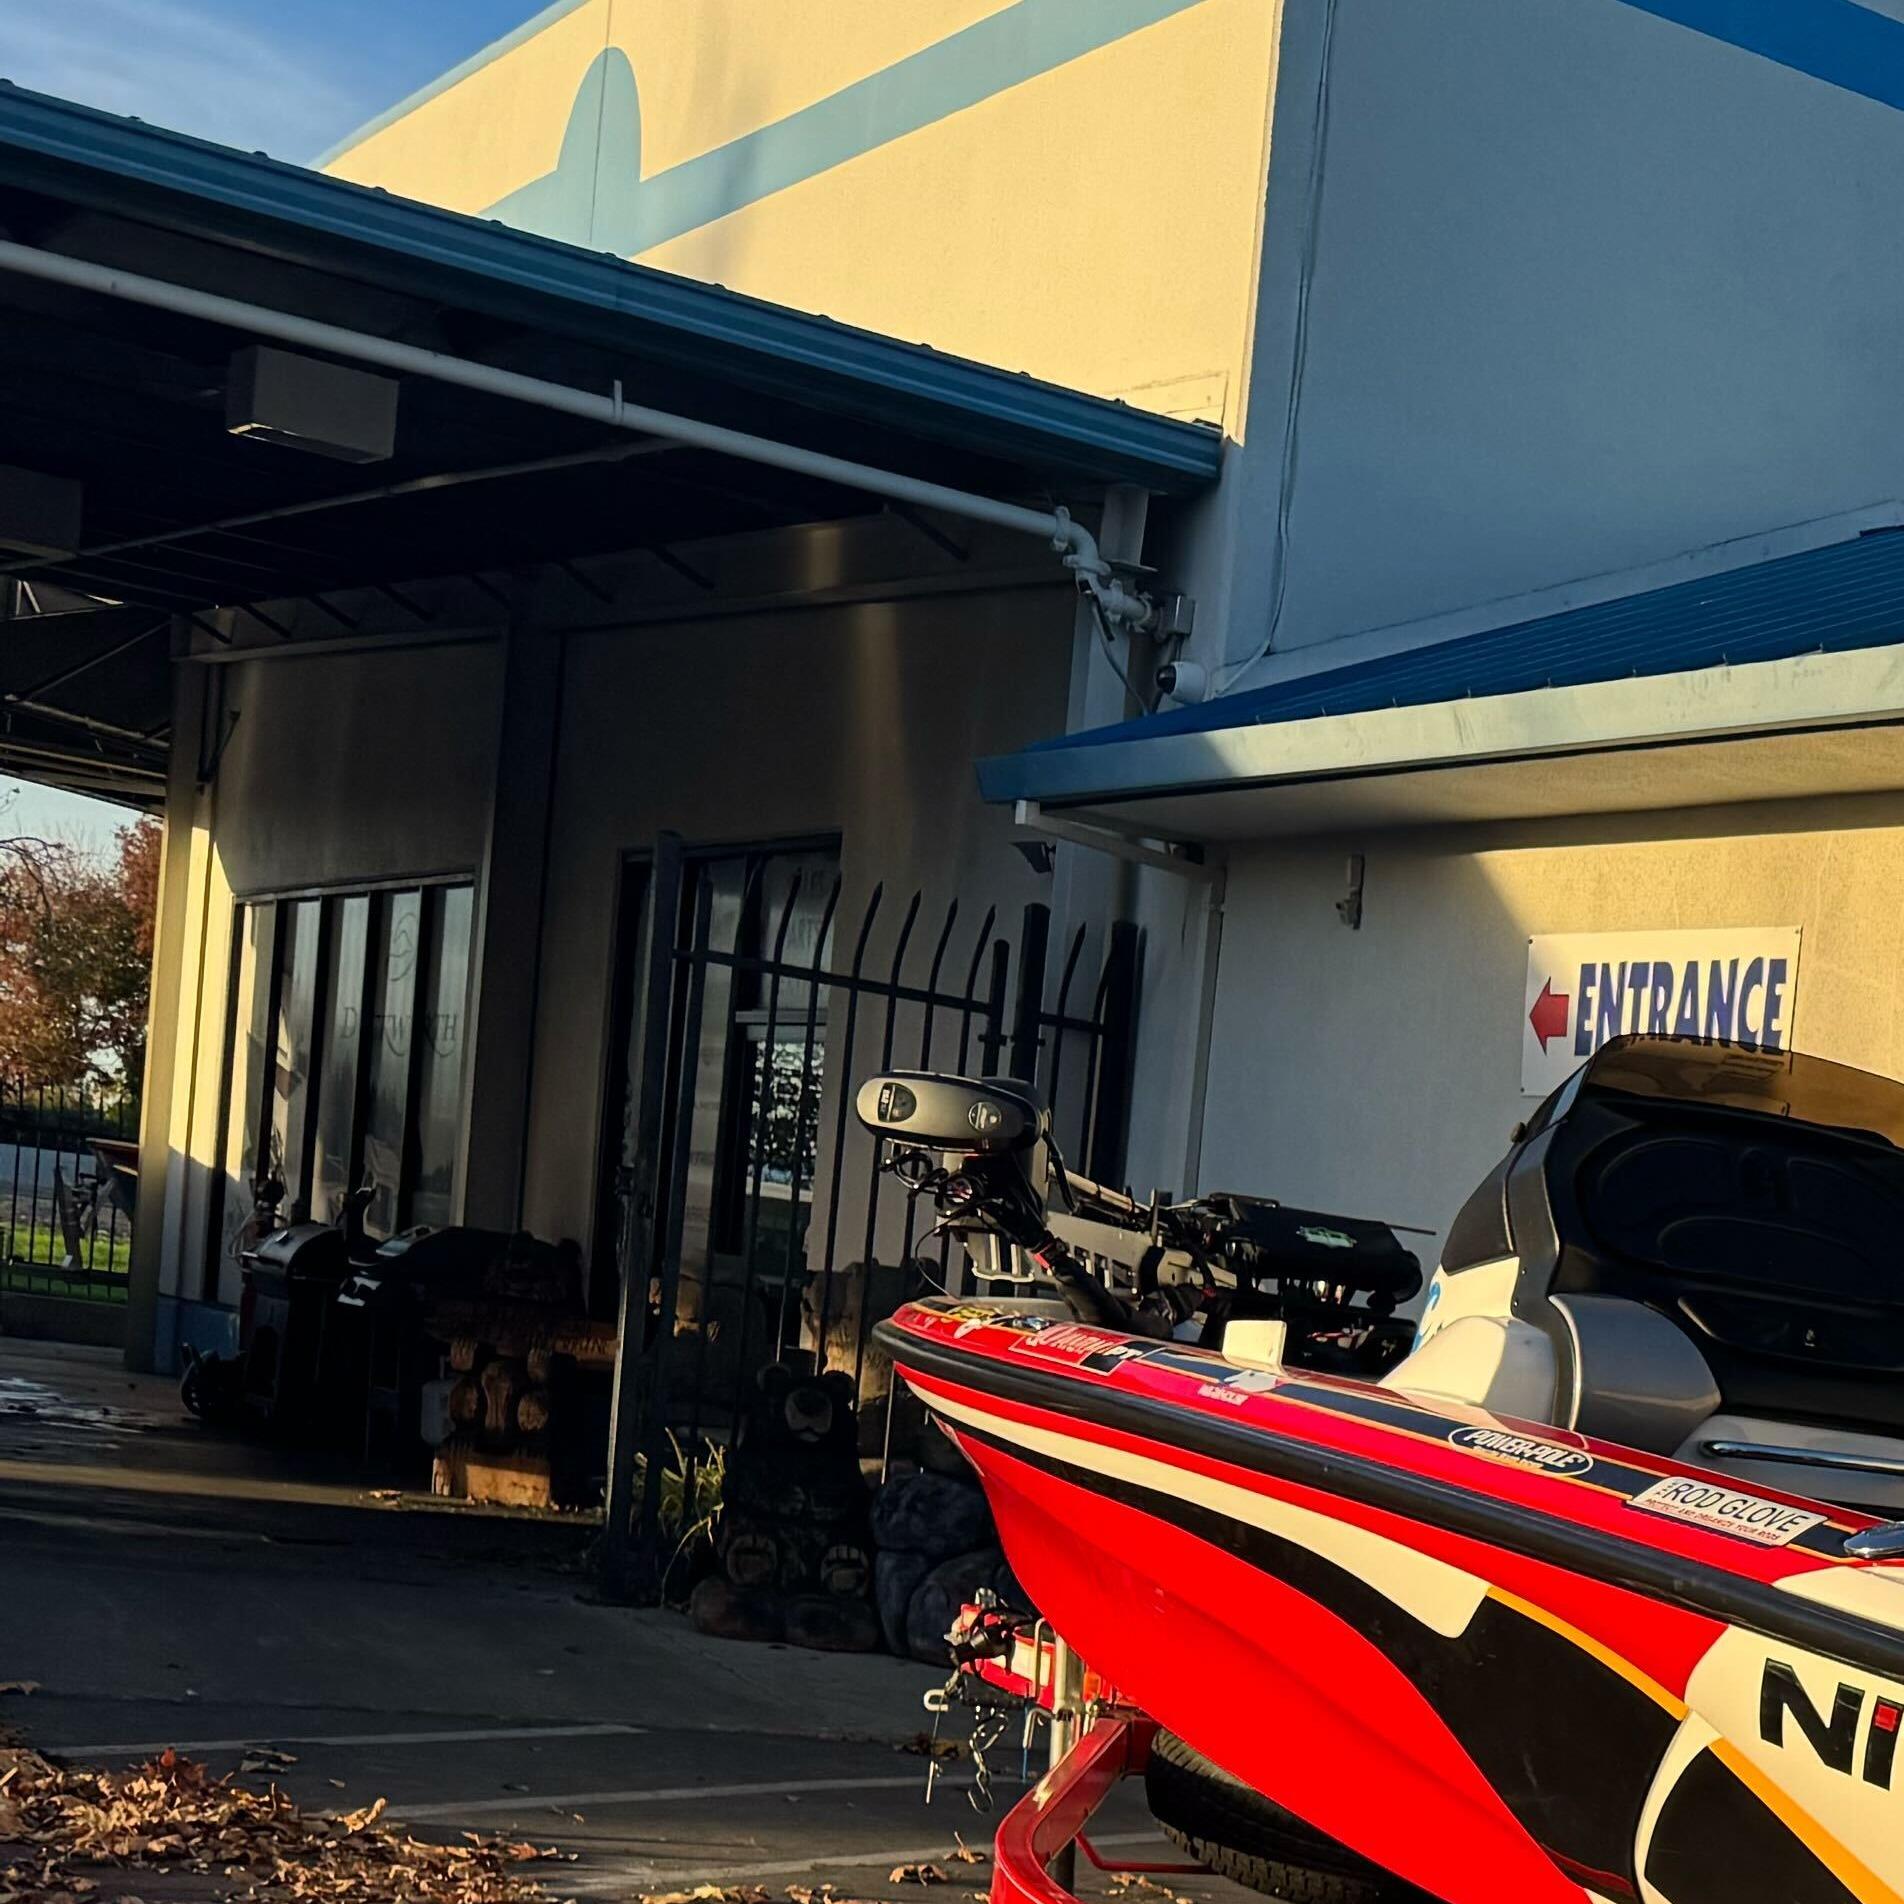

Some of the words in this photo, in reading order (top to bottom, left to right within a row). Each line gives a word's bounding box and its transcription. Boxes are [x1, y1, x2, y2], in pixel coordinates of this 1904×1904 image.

[1573, 957, 1788, 1056] ENTRANCE
[1463, 1429, 1582, 1468] POWER-POLE
[1661, 1483, 1726, 1509] ROD
[1718, 1498, 1808, 1532] GLOVE
